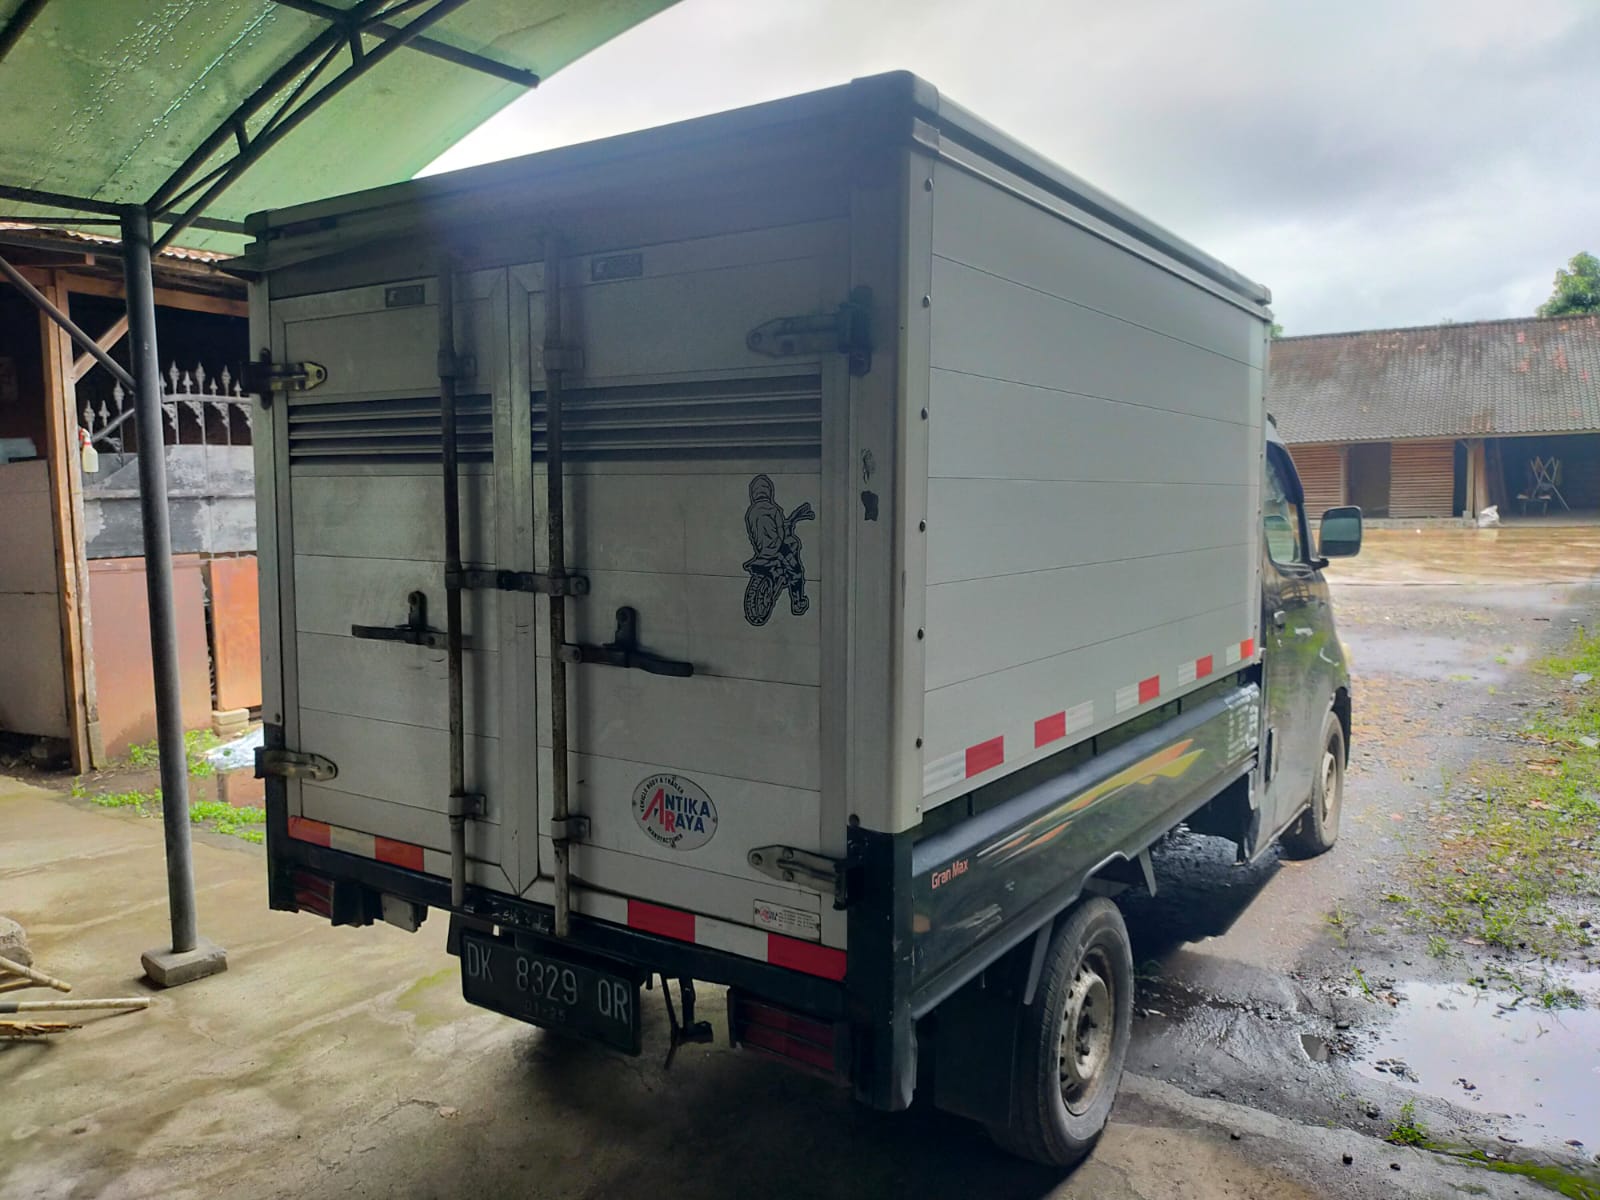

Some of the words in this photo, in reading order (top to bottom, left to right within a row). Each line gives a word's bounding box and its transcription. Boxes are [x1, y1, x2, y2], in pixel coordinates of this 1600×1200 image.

[642, 788, 711, 825] ANTIKA
[664, 810, 705, 834] RAYA
[931, 868, 952, 890] Gran
[952, 858, 969, 879] Max
[467, 943, 493, 982] DK
[516, 956, 578, 1006] 8329
